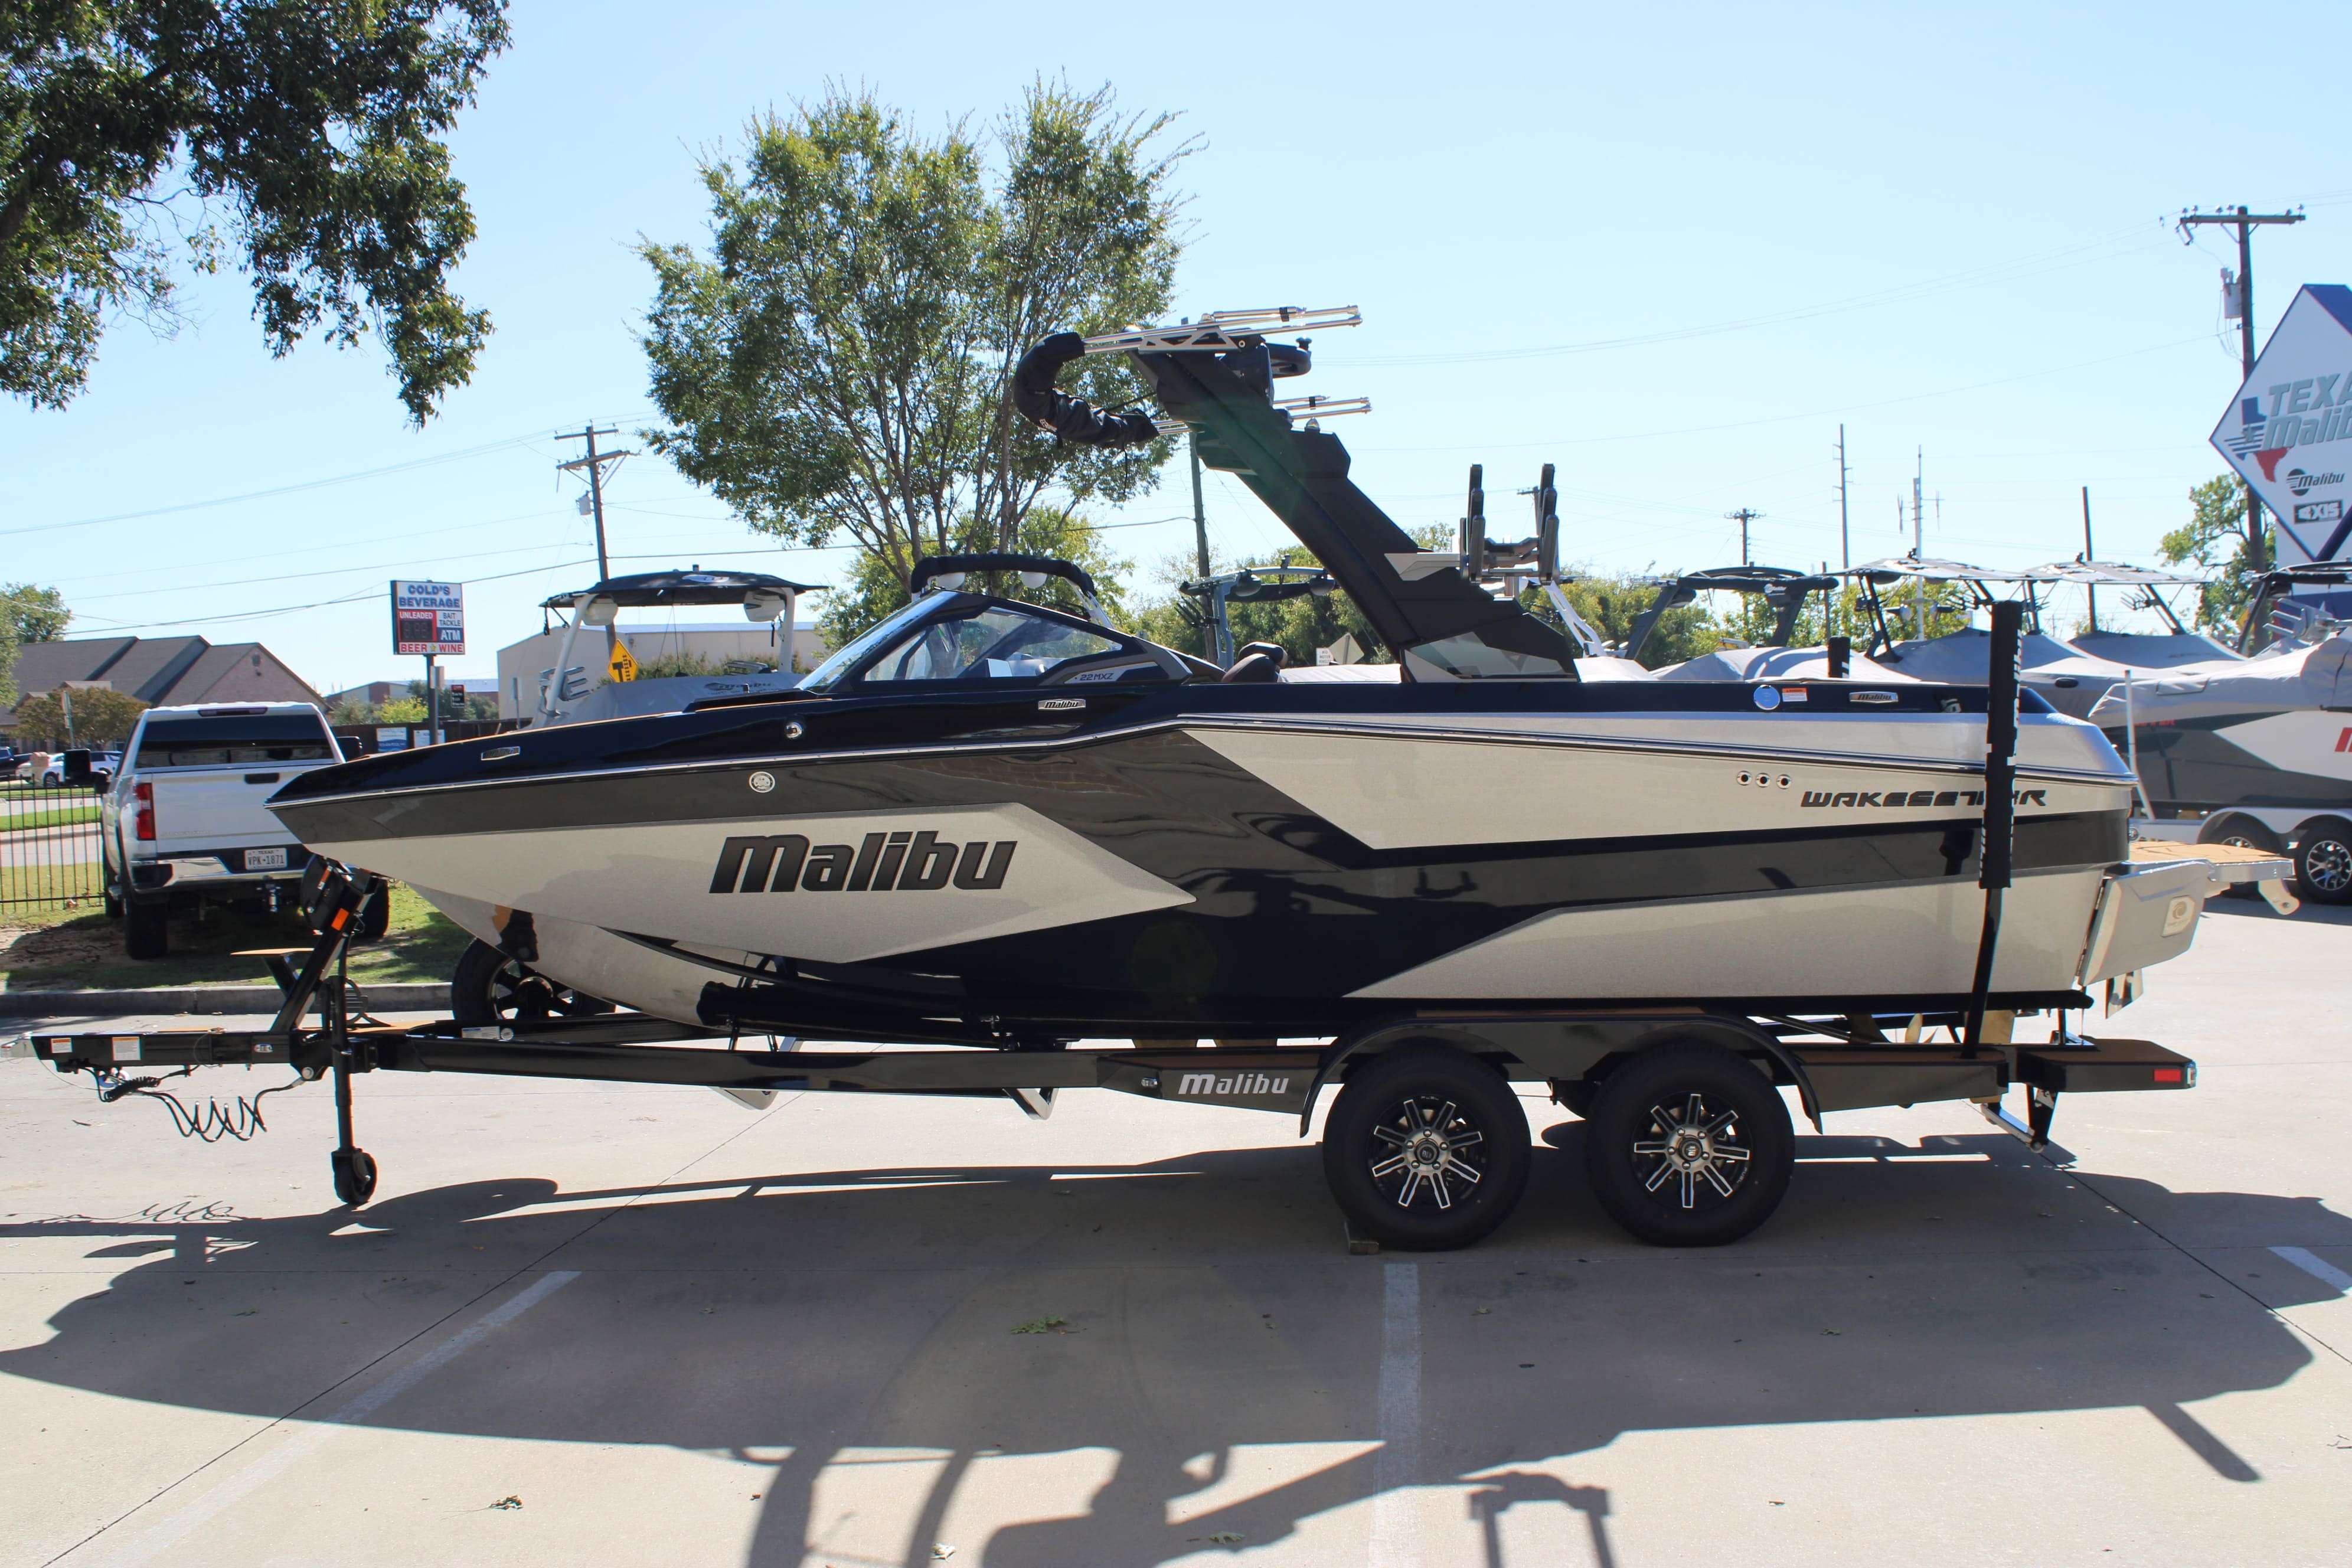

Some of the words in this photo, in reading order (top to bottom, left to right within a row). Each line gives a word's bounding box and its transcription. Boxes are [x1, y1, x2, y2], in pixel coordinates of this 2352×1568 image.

[2298, 472, 2345, 488] Malibu
[407, 584, 450, 596] COLD'S
[398, 596, 460, 609] BEVERAGE
[399, 611, 433, 619] UNLEADED
[440, 629, 461, 641] ATM
[401, 643, 427, 652] BEER
[439, 644, 463, 652] WINE
[1801, 789, 2047, 808] WAKESETR
[708, 831, 1018, 894] Malibu
[1178, 1073, 1289, 1095] Malibu
